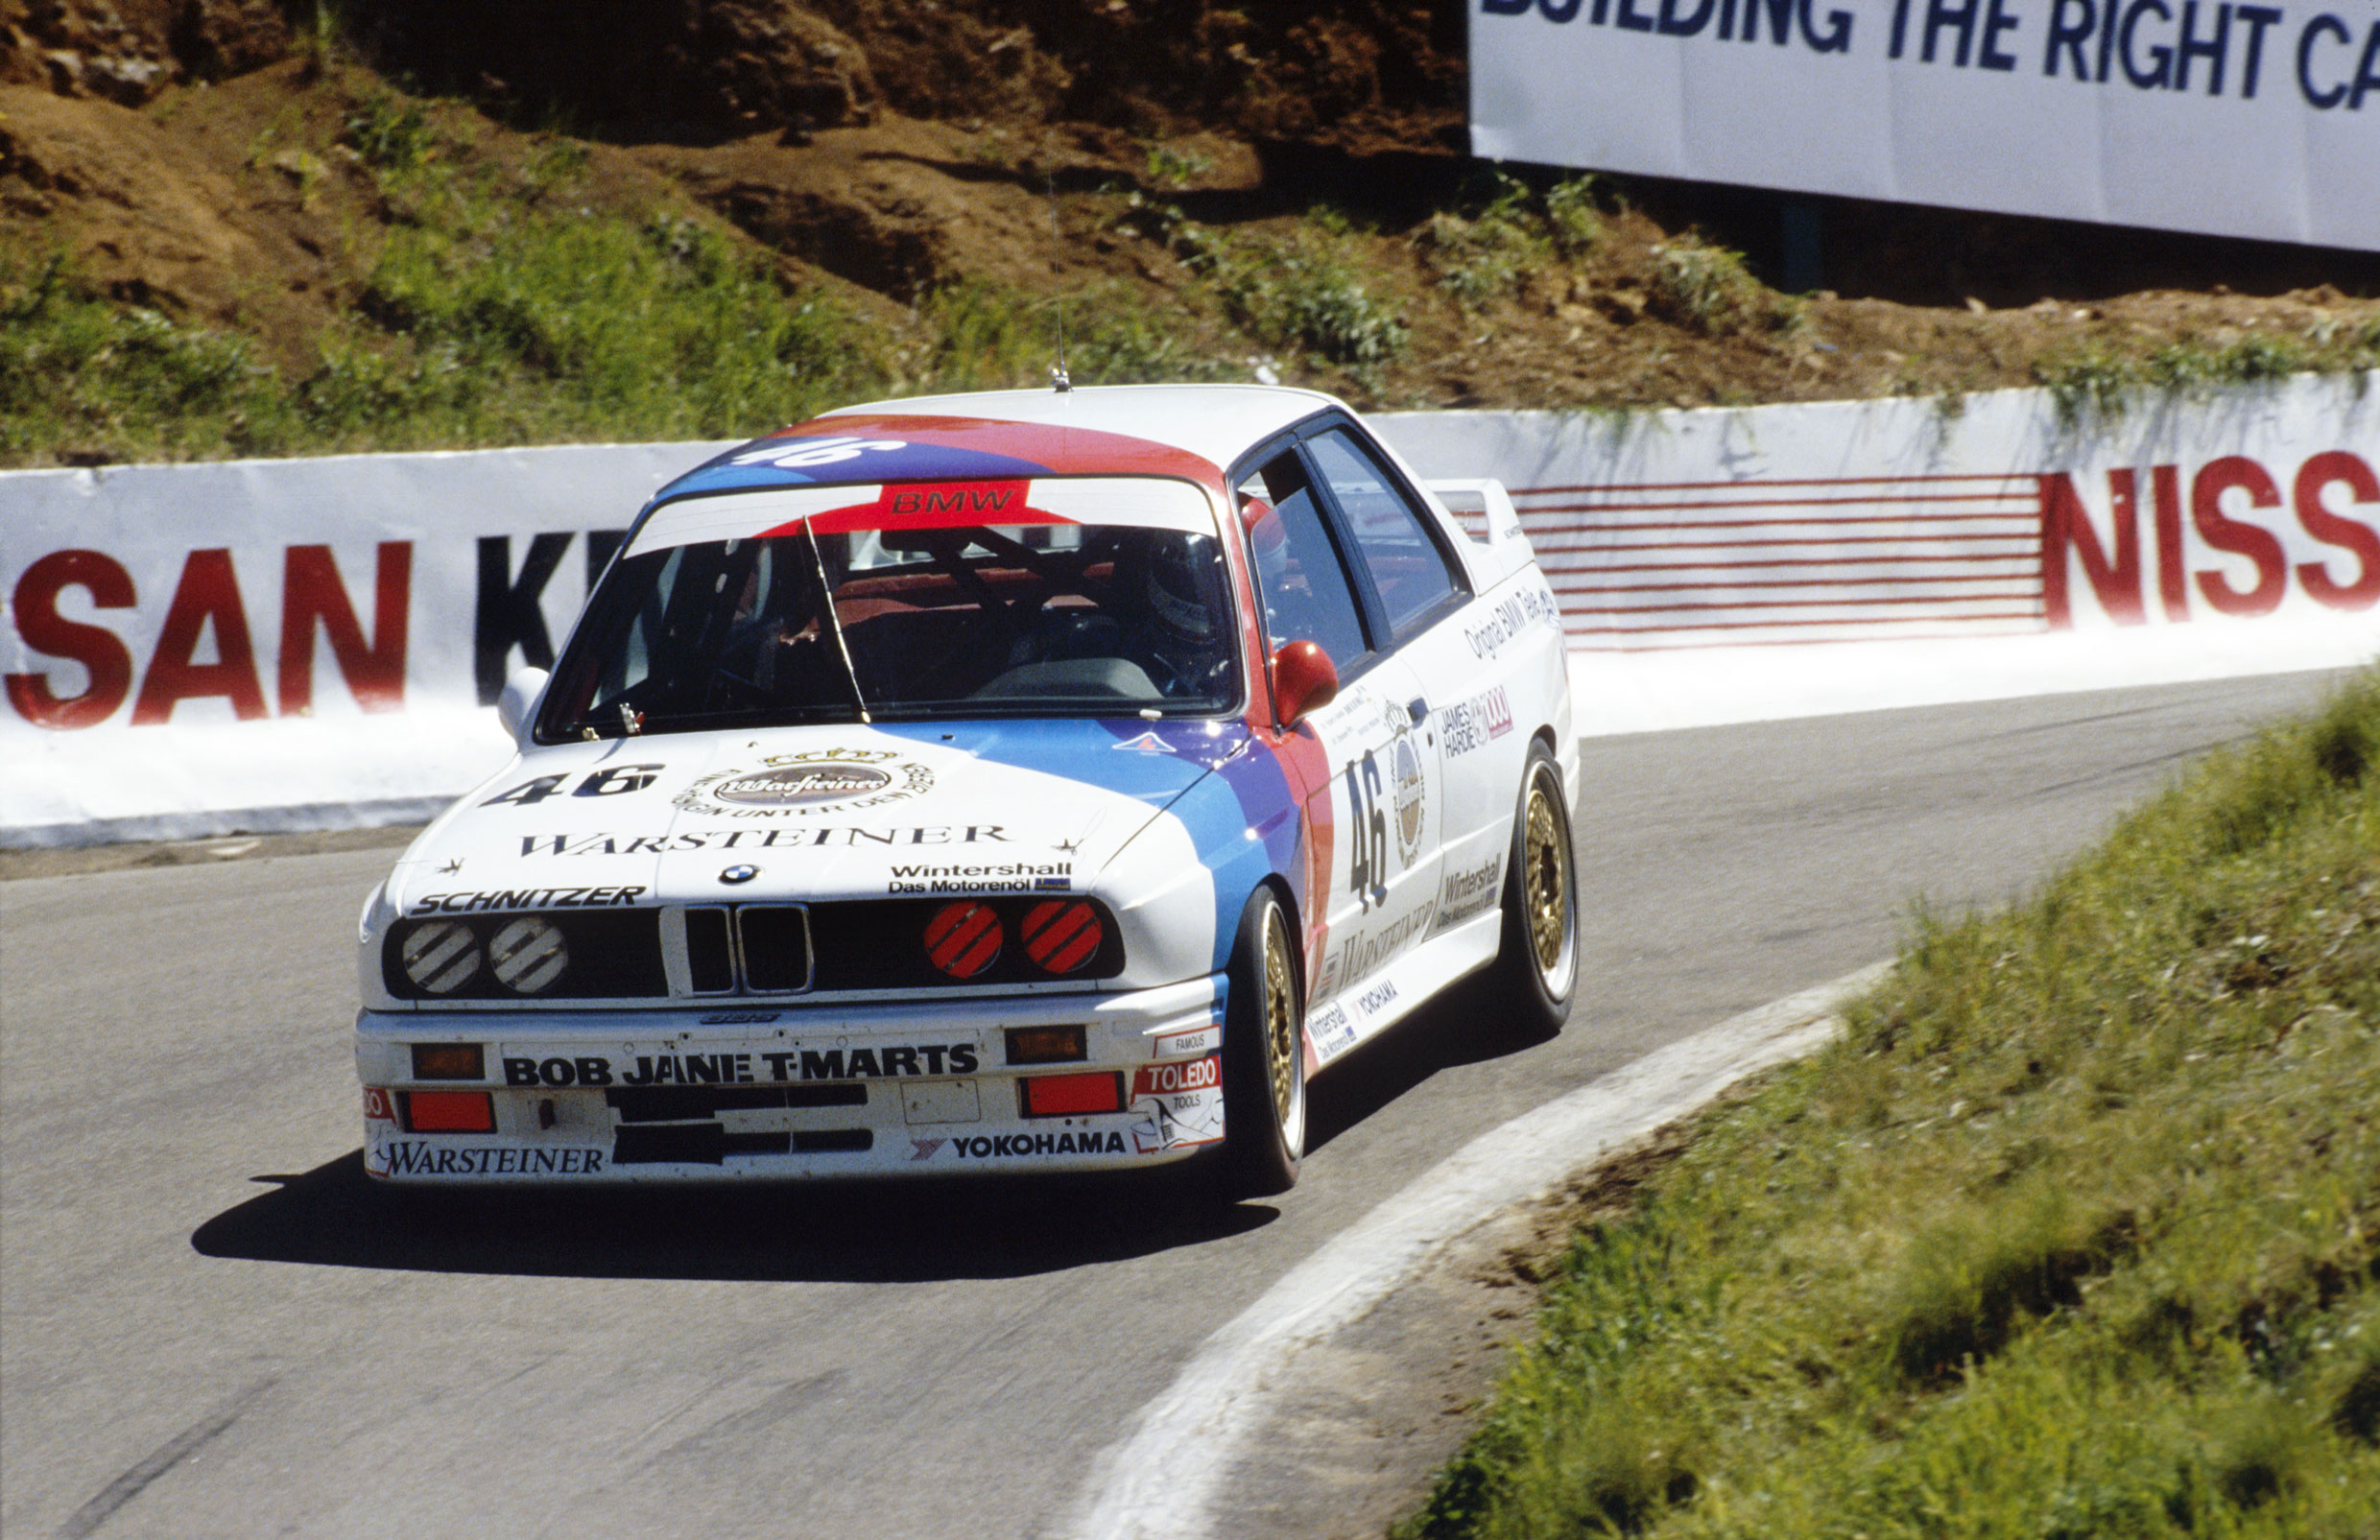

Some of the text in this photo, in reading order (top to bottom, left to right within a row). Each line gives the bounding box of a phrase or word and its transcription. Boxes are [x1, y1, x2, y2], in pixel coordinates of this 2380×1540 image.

[2043, 0, 2284, 99] RIGHT
[892, 489, 1014, 515] BMW
[2038, 450, 2380, 631] NISS
[4, 529, 629, 731] SAN K
[1442, 702, 1471, 735] JAMES
[1444, 726, 1476, 759] HARDIE
[477, 763, 666, 808] 46
[731, 804, 845, 817] UNTER
[519, 825, 1013, 858] WARSTEINER
[1345, 748, 1388, 915] 46
[888, 881, 926, 894] Das
[930, 878, 1031, 892] Motorenöl
[890, 862, 1072, 878] Wintershall
[1444, 852, 1501, 905] Wintershall
[411, 886, 647, 915] SCHNITZER
[1176, 1034, 1204, 1051] FAMOUS
[503, 1043, 979, 1086] BOB JANE T-MARTS
[1148, 1058, 1216, 1091] TOLEDO
[1174, 1094, 1201, 1110] TOOLS
[388, 1141, 603, 1175] WARSTEINER
[952, 1131, 1127, 1158] YOKOHAMA
